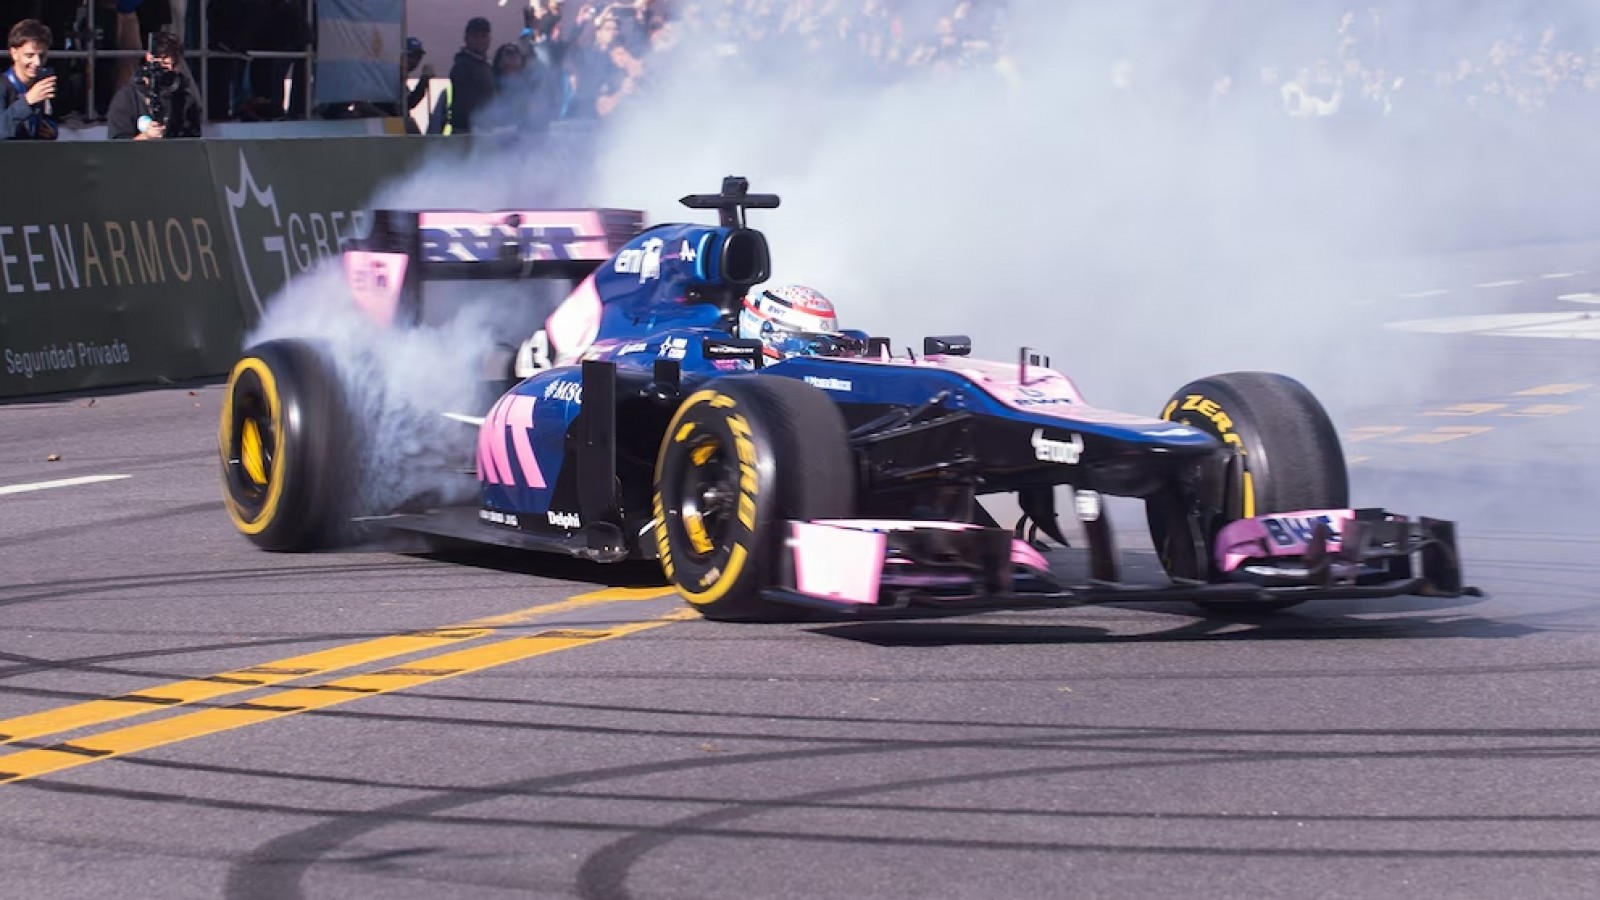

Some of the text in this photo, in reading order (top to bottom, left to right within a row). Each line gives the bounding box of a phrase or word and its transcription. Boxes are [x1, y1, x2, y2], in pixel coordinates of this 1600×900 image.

[0, 217, 221, 293] EENARMOR
[4, 339, 130, 378] Seguridad Privada
[547, 511, 580, 530] Delphi
